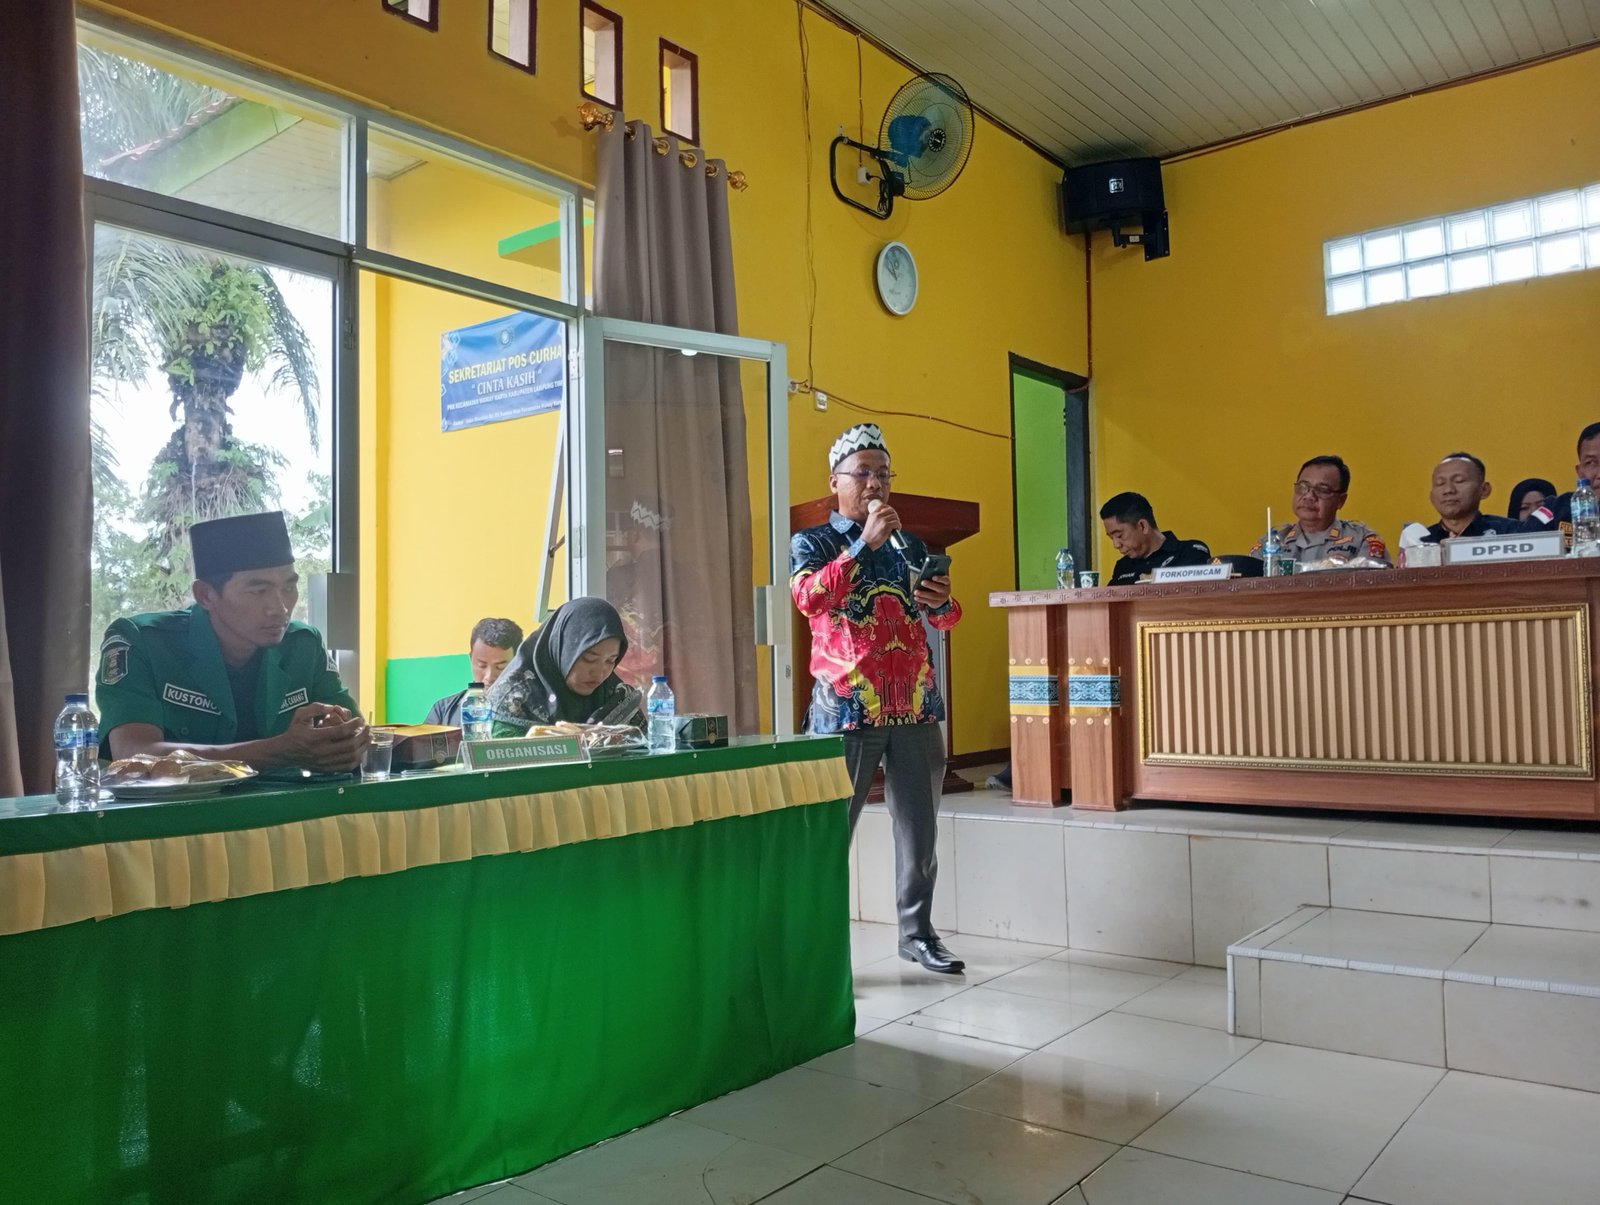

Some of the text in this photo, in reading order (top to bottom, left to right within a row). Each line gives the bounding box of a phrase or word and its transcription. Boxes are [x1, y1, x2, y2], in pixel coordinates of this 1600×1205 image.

[448, 344, 562, 384] SEKRETARIAT POS CURHA
[477, 371, 536, 395] CINTA KASIH
[1472, 543, 1534, 556] DPRD
[1160, 568, 1222, 579] FORKOPIMCAM
[486, 744, 568, 760] ORGANISASI
